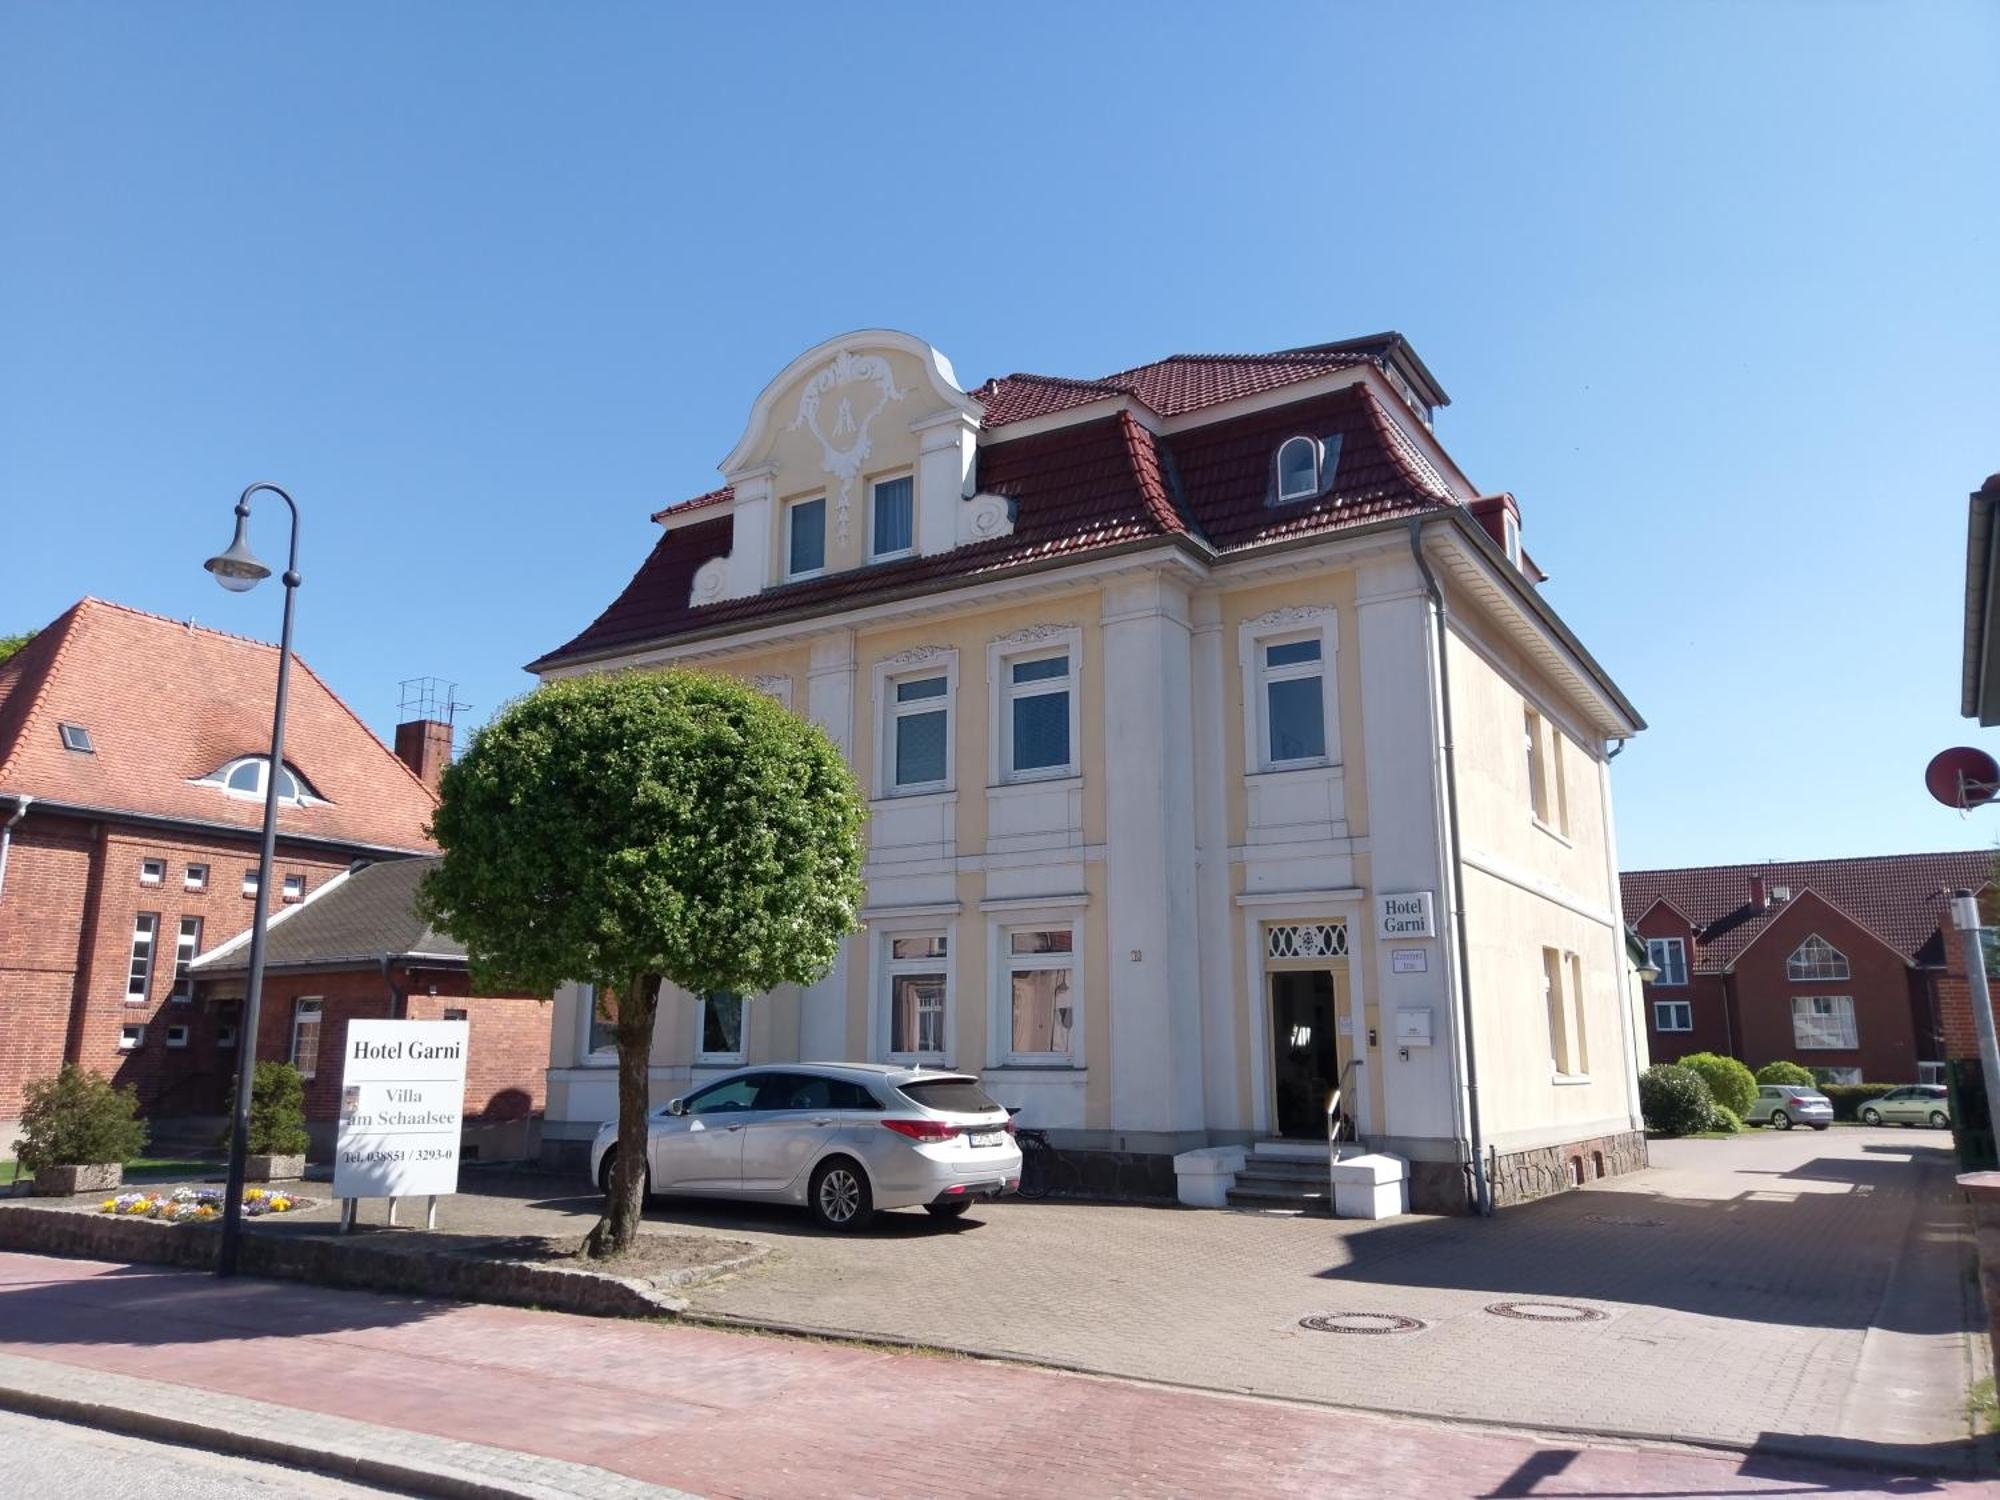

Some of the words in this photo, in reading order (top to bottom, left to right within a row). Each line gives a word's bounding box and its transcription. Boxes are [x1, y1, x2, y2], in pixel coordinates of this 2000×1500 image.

[1385, 899, 1422, 914] Hotel
[1384, 917, 1425, 932] Garni
[353, 1041, 402, 1059] Hotel
[408, 1041, 460, 1060] Garni
[386, 1088, 422, 1102] Villa
[347, 1116, 372, 1126] am
[377, 1110, 455, 1126] Schaalsee
[367, 1150, 405, 1162] 038851
